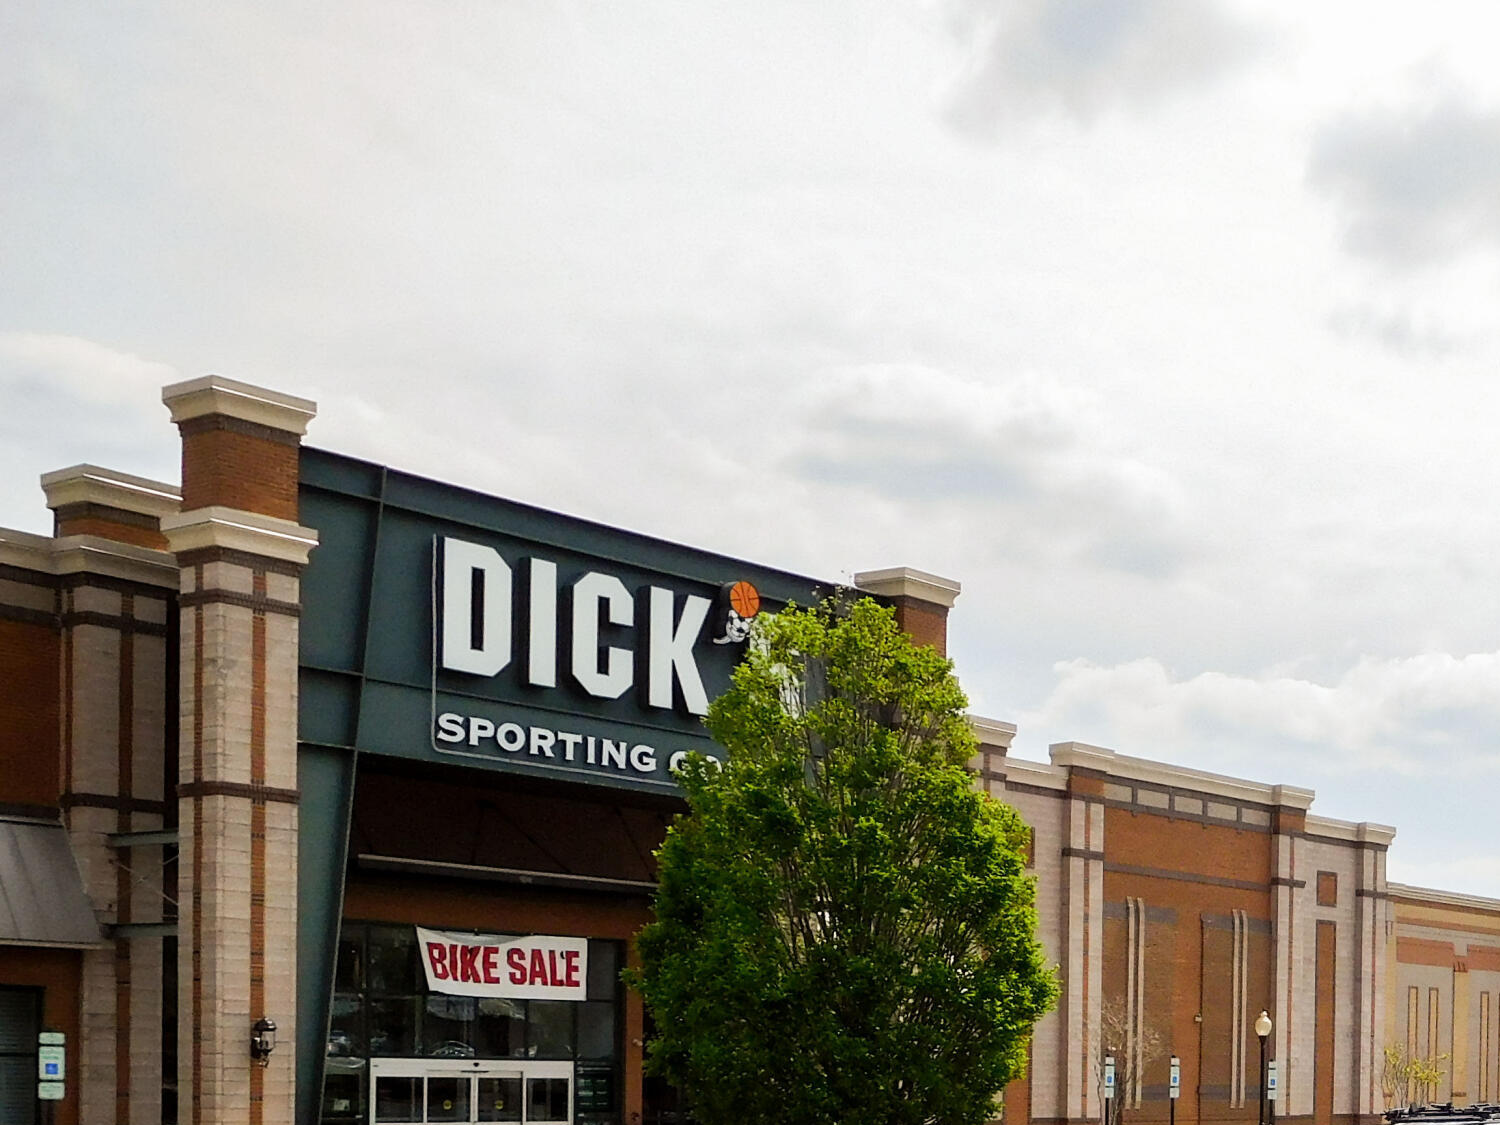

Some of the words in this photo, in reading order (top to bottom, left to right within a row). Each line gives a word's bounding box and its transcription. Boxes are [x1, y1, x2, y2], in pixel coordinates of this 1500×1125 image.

[436, 712, 658, 773] SPORTING
[426, 942, 500, 984] BIKE
[507, 948, 580, 987] SALE
